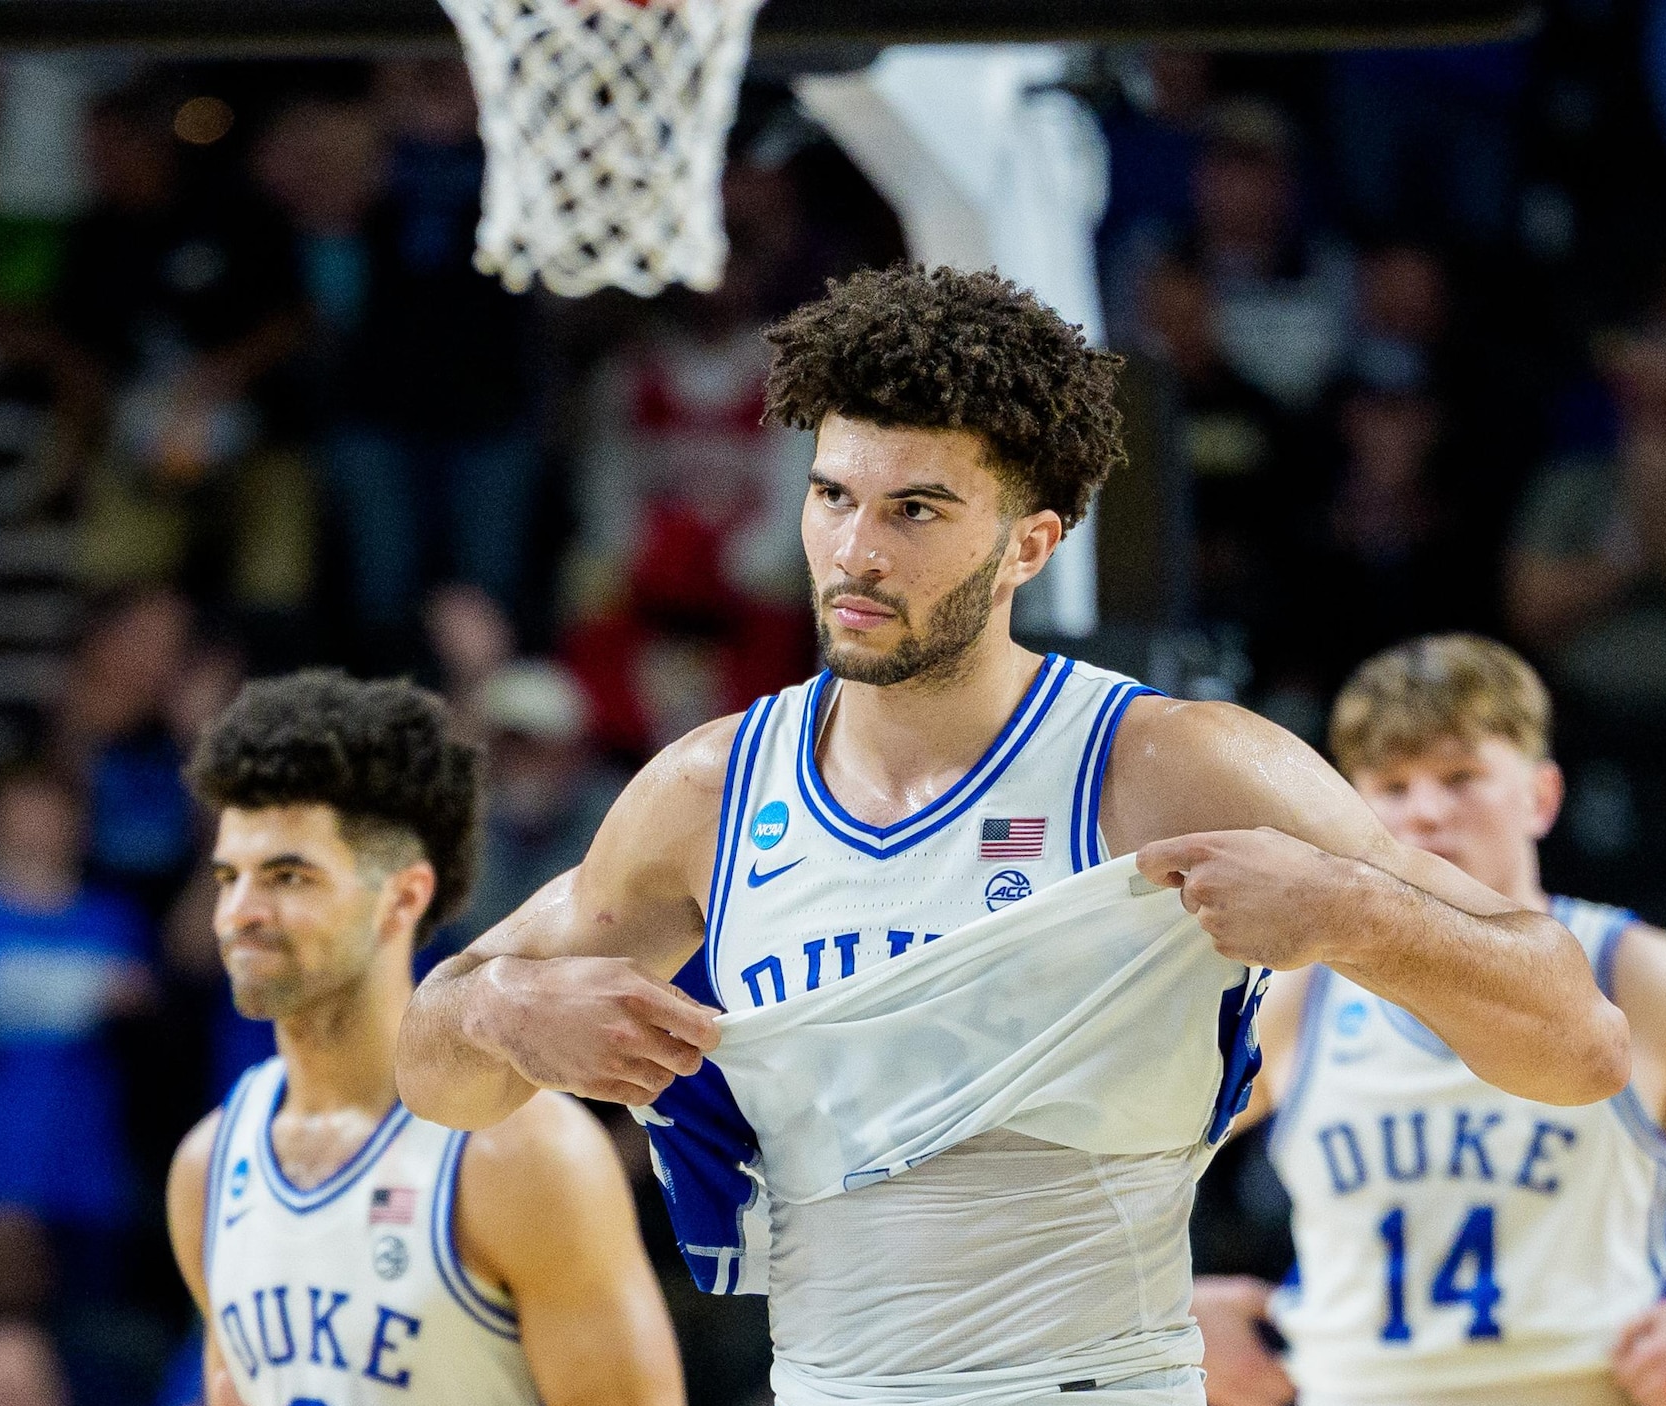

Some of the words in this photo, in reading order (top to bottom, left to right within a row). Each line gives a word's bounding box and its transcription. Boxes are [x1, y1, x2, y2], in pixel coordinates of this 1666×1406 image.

[754, 822, 784, 837] NCAA
[992, 886, 1031, 898] ACC
[1317, 1107, 1578, 1196] DUKE
[1378, 1204, 1503, 1343] 14
[221, 1286, 421, 1389] DUKE
